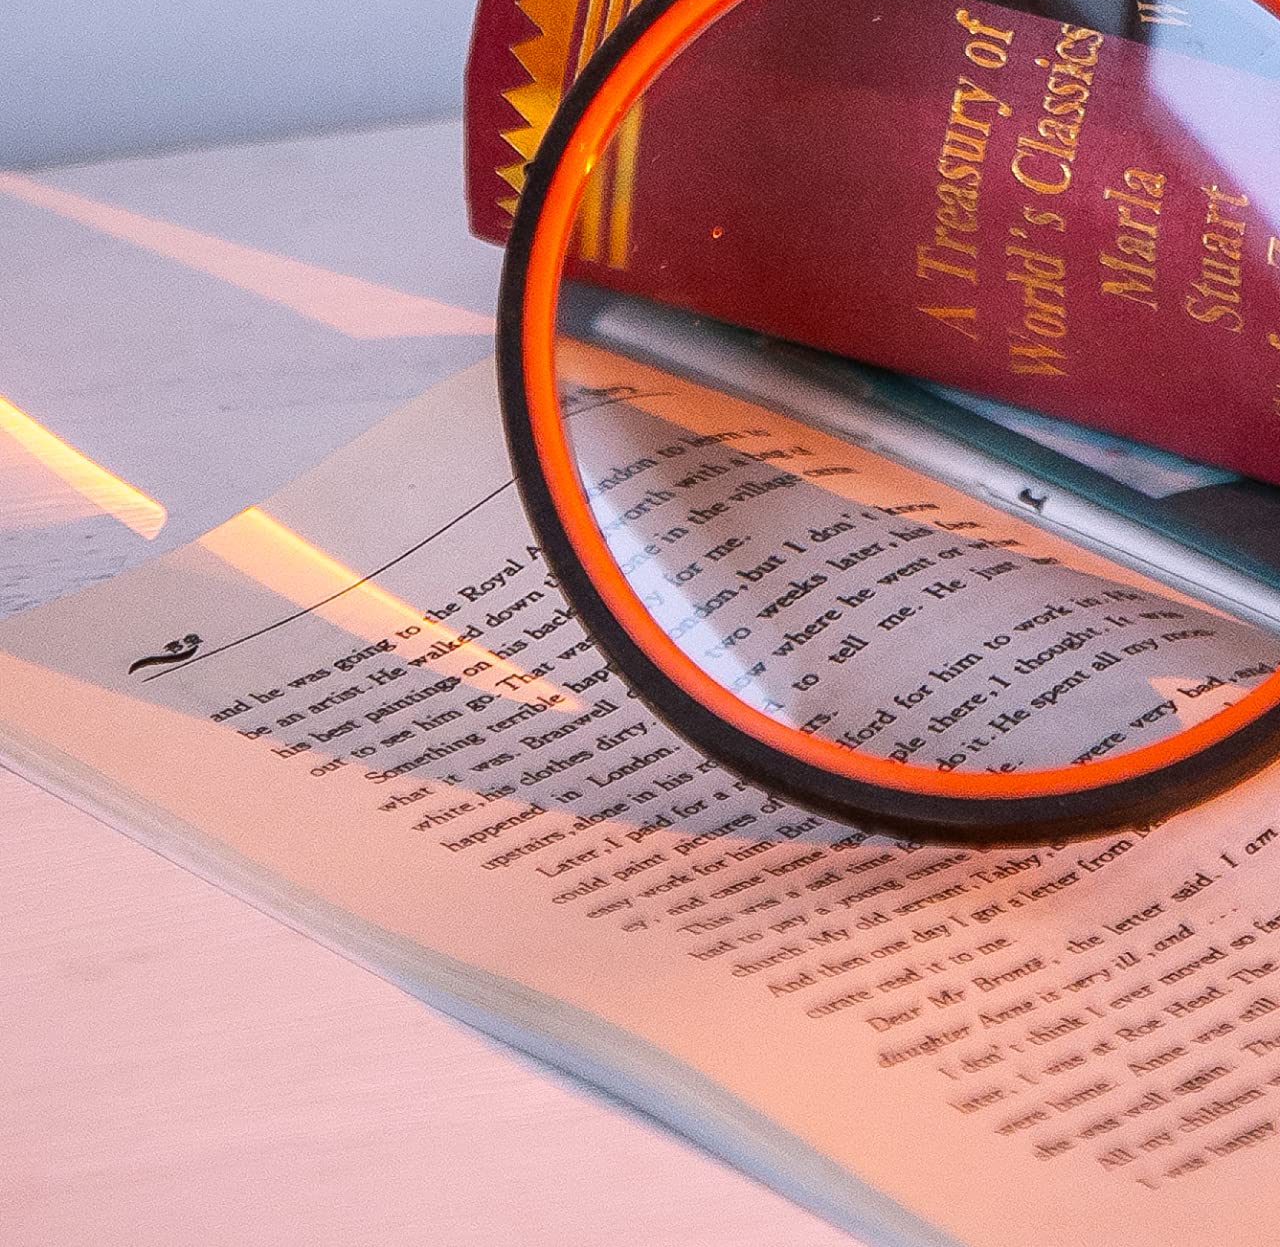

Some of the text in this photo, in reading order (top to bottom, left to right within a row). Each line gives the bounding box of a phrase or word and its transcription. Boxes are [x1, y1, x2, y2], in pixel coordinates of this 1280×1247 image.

[1010, 24, 1103, 196] Classics
[917, 8, 1016, 340] A Treasury of
[1100, 166, 1167, 310] Marla
[1184, 184, 1248, 333] Stuart
[1007, 206, 1069, 378] World's
[688, 473, 803, 525] the village
[737, 555, 788, 583] but
[756, 572, 828, 619] weeks
[772, 547, 964, 656] where he went or
[209, 700, 250, 723] and
[254, 686, 285, 712] he
[287, 667, 331, 690] was
[333, 640, 397, 674] going
[396, 622, 422, 641] to
[423, 600, 461, 626] the
[457, 557, 524, 604] Royal
[237, 588, 545, 741] be an walked down
[270, 604, 577, 761] his best paintings on his back
[792, 673, 820, 691] to
[829, 636, 869, 664] tell
[878, 605, 924, 631] me.
[922, 580, 967, 599] He
[893, 604, 1073, 710] for him to work
[309, 757, 349, 778] out
[350, 743, 377, 760] to
[380, 727, 416, 748] see
[414, 707, 461, 734] him
[495, 658, 555, 691] That
[364, 690, 567, 785] Something terrible
[993, 638, 1158, 736] He spent all my
[1130, 700, 1178, 729] very
[377, 698, 619, 814] what it Branwell
[440, 746, 680, 854] happened in London.
[484, 749, 594, 803] his clothes
[573, 771, 693, 830] alone in his
[552, 813, 757, 904] could paint pictures
[585, 815, 823, 919] easy work for But
[625, 800, 709, 843] paid for
[677, 915, 734, 936] This
[805, 872, 842, 893] sad
[846, 852, 897, 874] time
[709, 850, 828, 900] came home
[738, 854, 972, 945] to pay young curate
[768, 838, 1133, 997] And then one day got letter from
[856, 912, 892, 931] old
[864, 1005, 922, 1032] Dear
[927, 989, 965, 1009] Mr
[1066, 934, 1103, 955] the
[1103, 902, 1166, 937] letter
[1245, 826, 1279, 855] am
[977, 1001, 1038, 1029] Anne
[1062, 966, 1110, 994] very
[1026, 1016, 1090, 1048] think
[1109, 984, 1155, 1009] ever
[1157, 947, 1228, 987] moved
[1230, 932, 1256, 950] so
[1116, 1017, 1168, 1043] Roe
[1230, 961, 1279, 987] The
[1126, 1045, 1187, 1077] Anne
[1179, 1085, 1264, 1135] children
